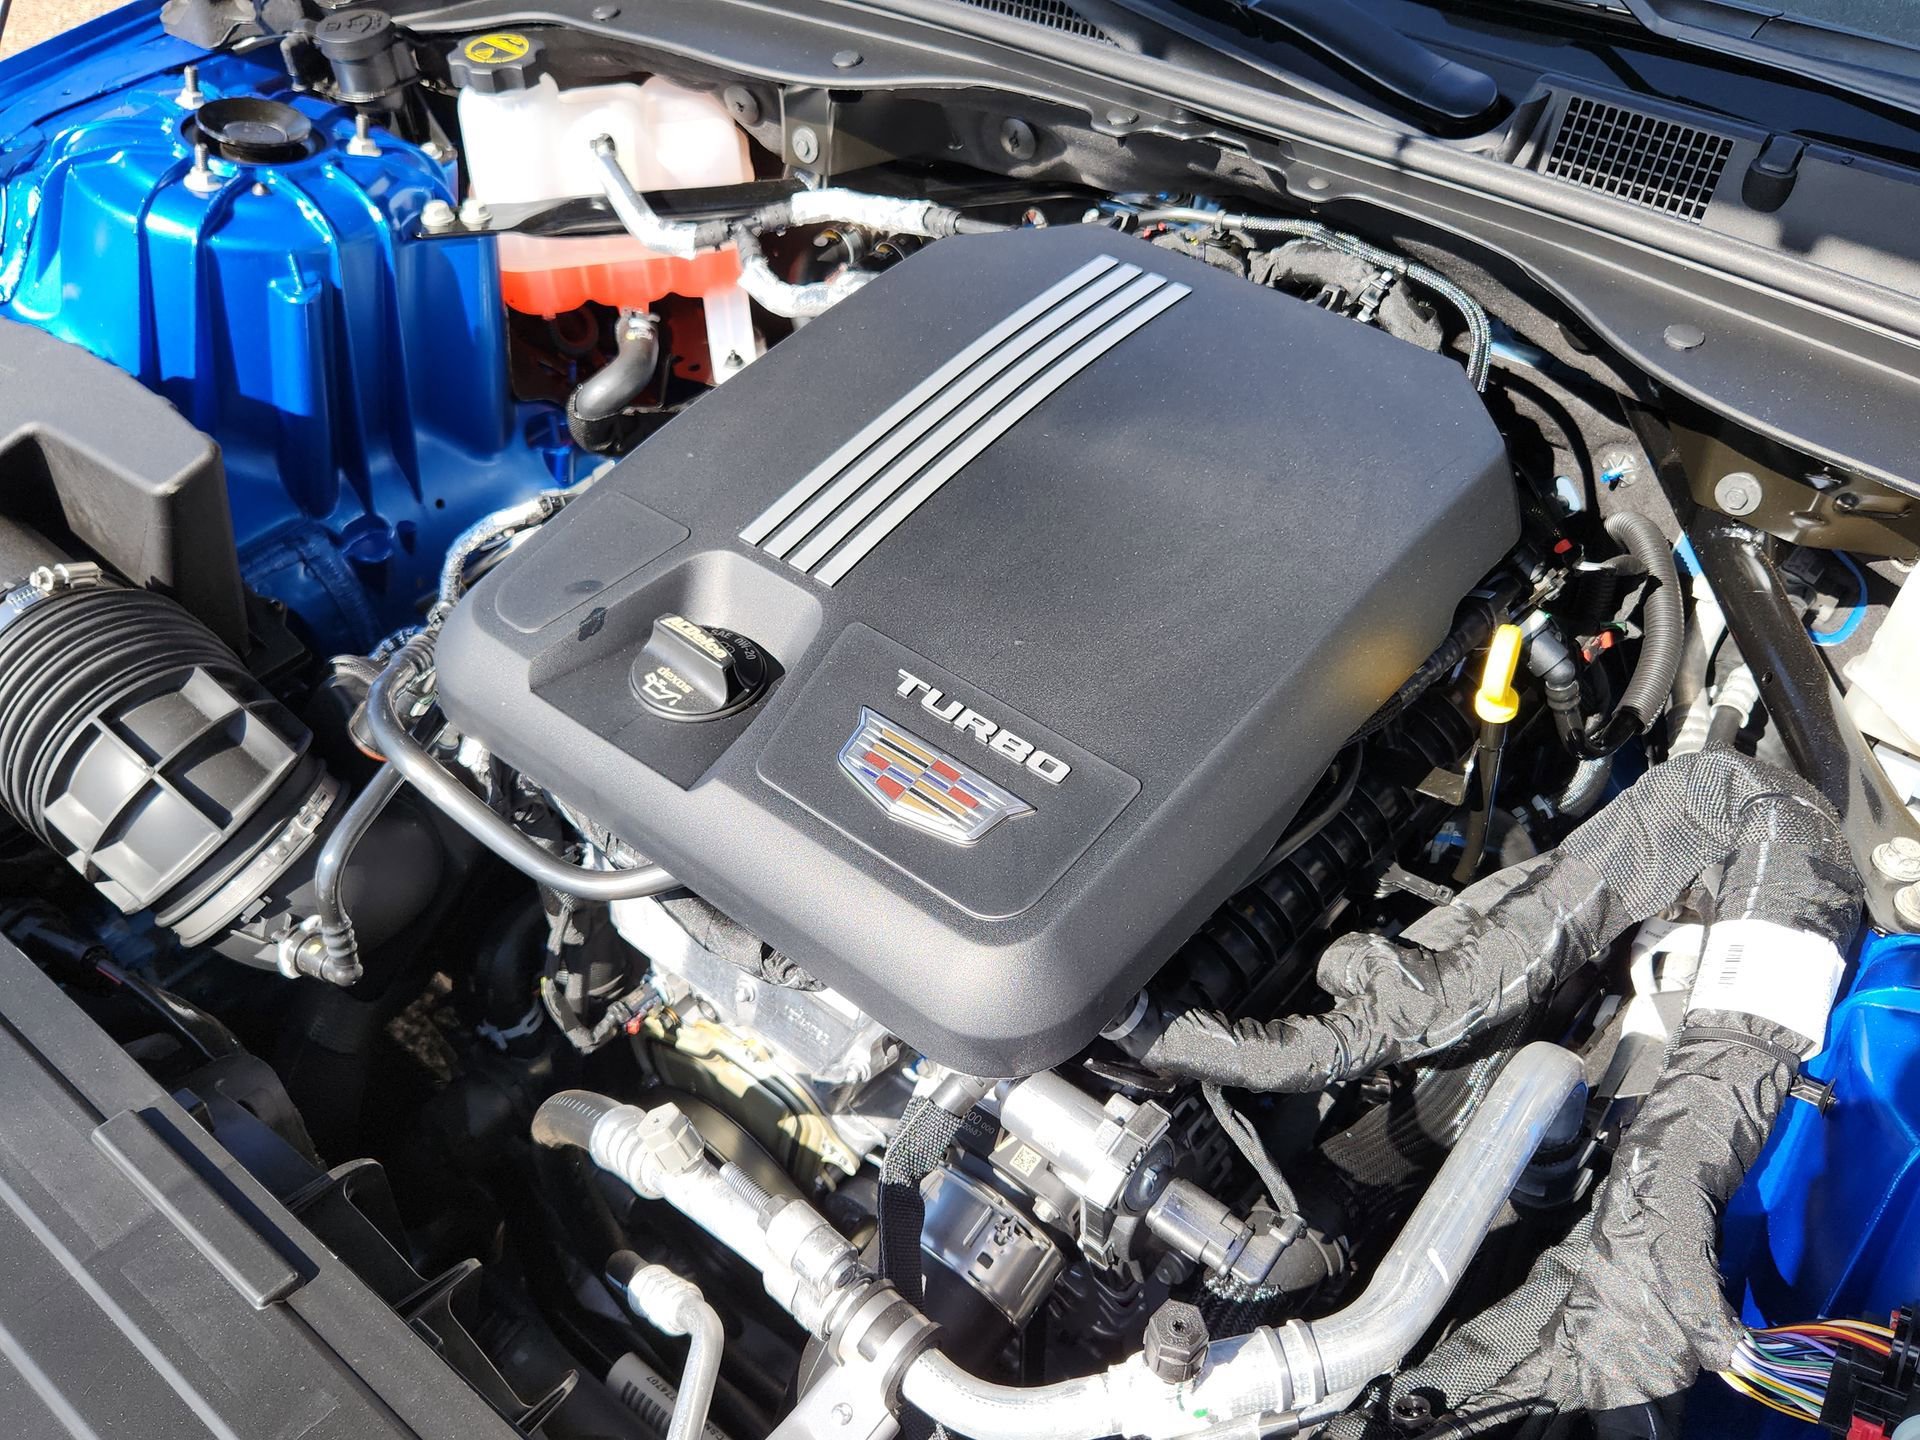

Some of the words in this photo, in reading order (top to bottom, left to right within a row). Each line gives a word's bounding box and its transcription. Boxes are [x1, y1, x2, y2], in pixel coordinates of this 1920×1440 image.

[660, 616, 728, 660] ACDelco
[711, 629, 733, 639] SAE
[734, 637, 757, 660] 0W-20
[656, 666, 695, 694] dexos
[897, 668, 1072, 786] TURBO
